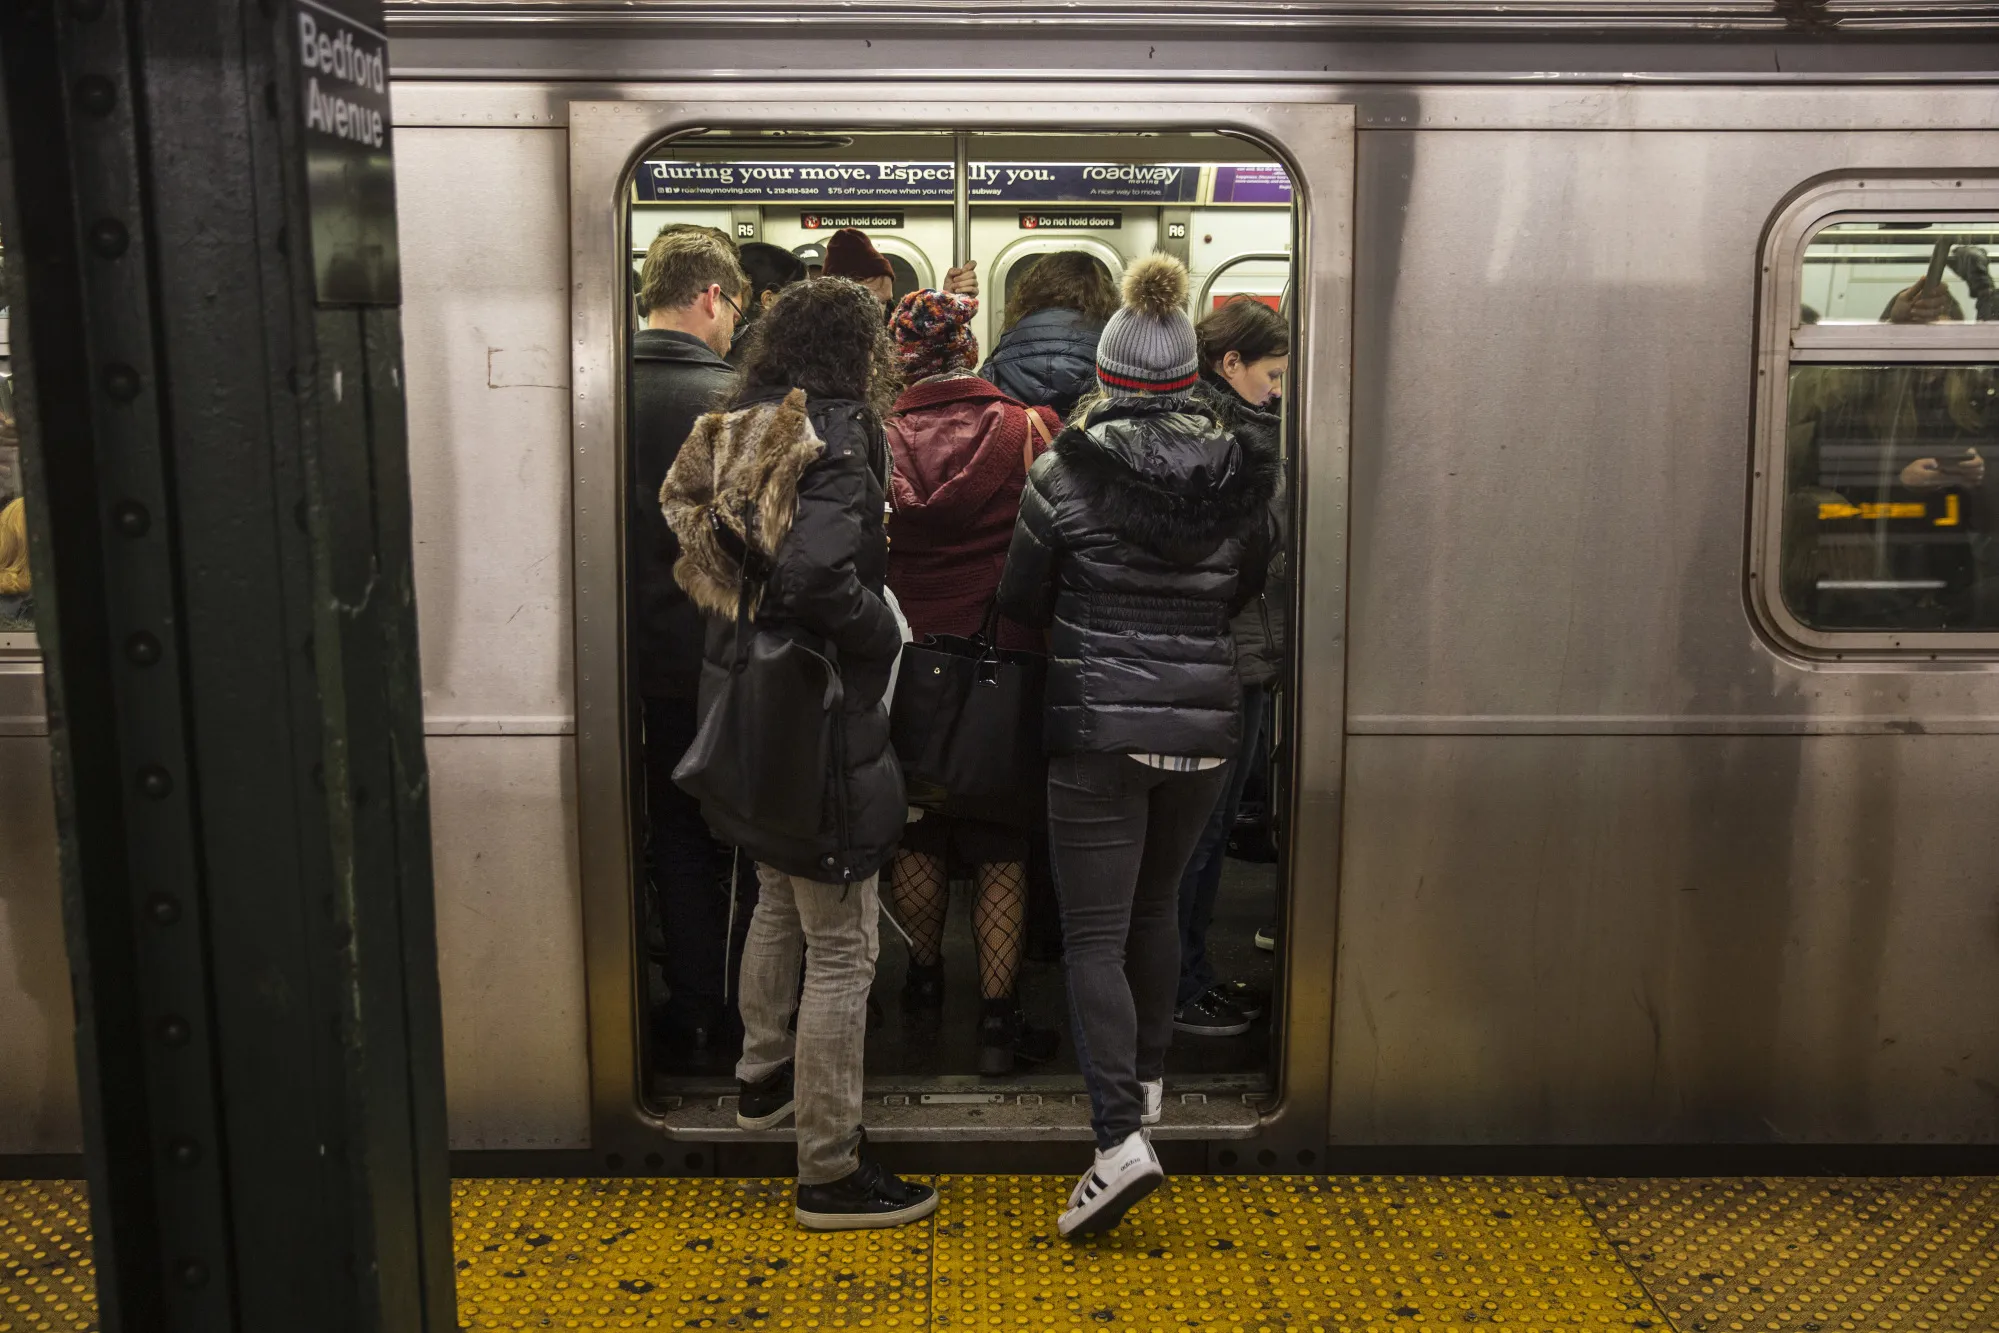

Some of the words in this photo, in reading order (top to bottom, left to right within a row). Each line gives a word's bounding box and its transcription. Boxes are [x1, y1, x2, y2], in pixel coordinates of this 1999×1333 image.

[298, 12, 385, 94] Bedford
[306, 77, 384, 148] Avenue
[653, 162, 734, 184] during
[738, 167, 795, 185] your
[799, 167, 871, 180] move.
[1005, 168, 1056, 186] you.
[1082, 164, 1181, 185] roadway
[827, 187, 843, 195] $75
[856, 188, 875, 196] your
[971, 187, 1002, 196] subway
[821, 216, 834, 226] Do
[835, 217, 850, 226] not
[851, 216, 870, 226] hold
[871, 216, 897, 226] doors
[1039, 216, 1052, 226] Do
[1053, 217, 1068, 226] not
[1068, 216, 1088, 226] hold
[1089, 216, 1115, 226] doors
[738, 224, 754, 237] R5
[1168, 224, 1185, 237] R6
